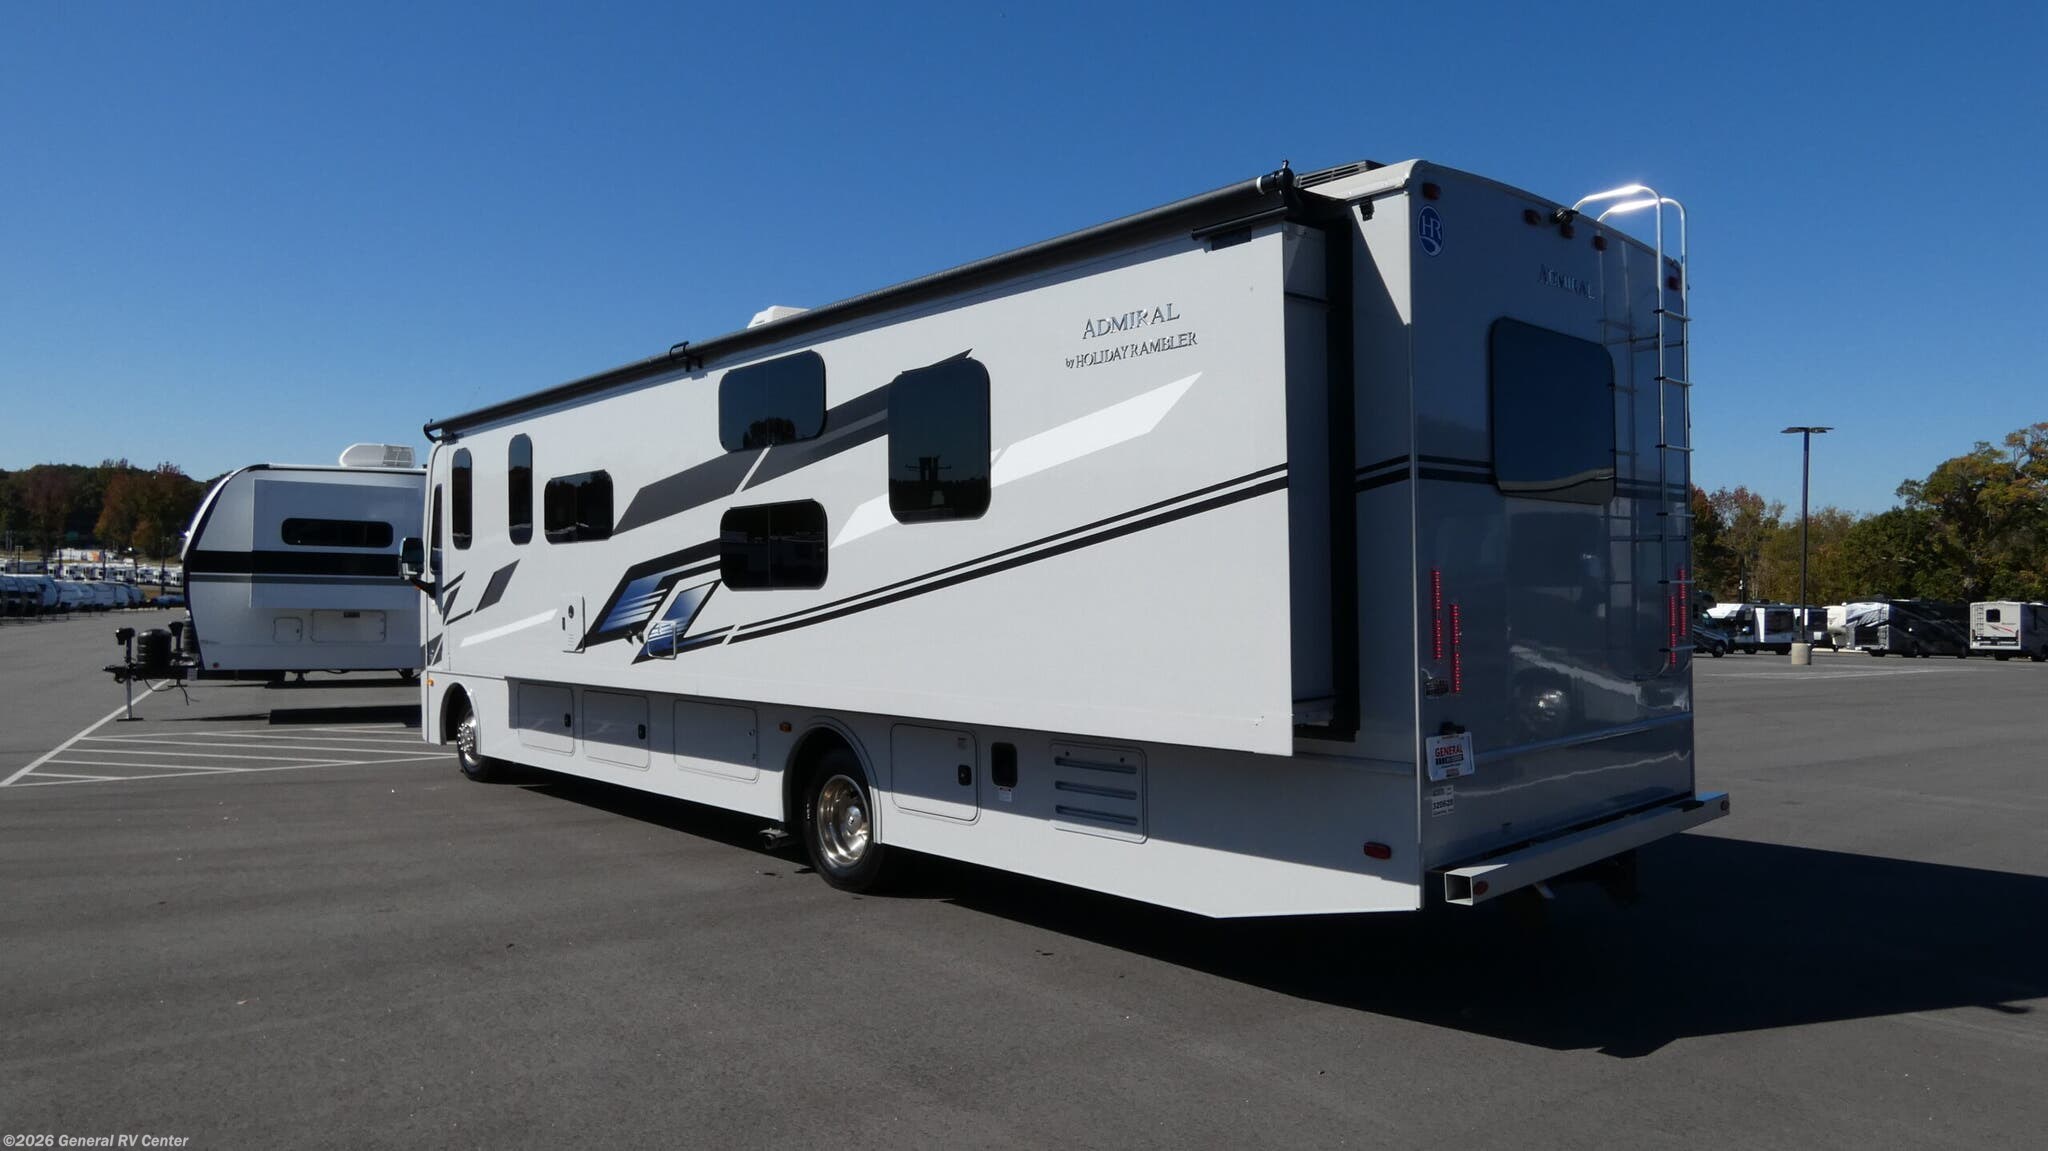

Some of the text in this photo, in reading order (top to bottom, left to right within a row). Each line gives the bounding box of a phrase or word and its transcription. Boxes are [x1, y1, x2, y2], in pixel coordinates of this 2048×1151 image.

[1421, 215, 1442, 241] HR
[1082, 303, 1180, 340] ADMIRAL
[1065, 356, 1075, 369] by
[1434, 744, 1463, 757] GENERAL
